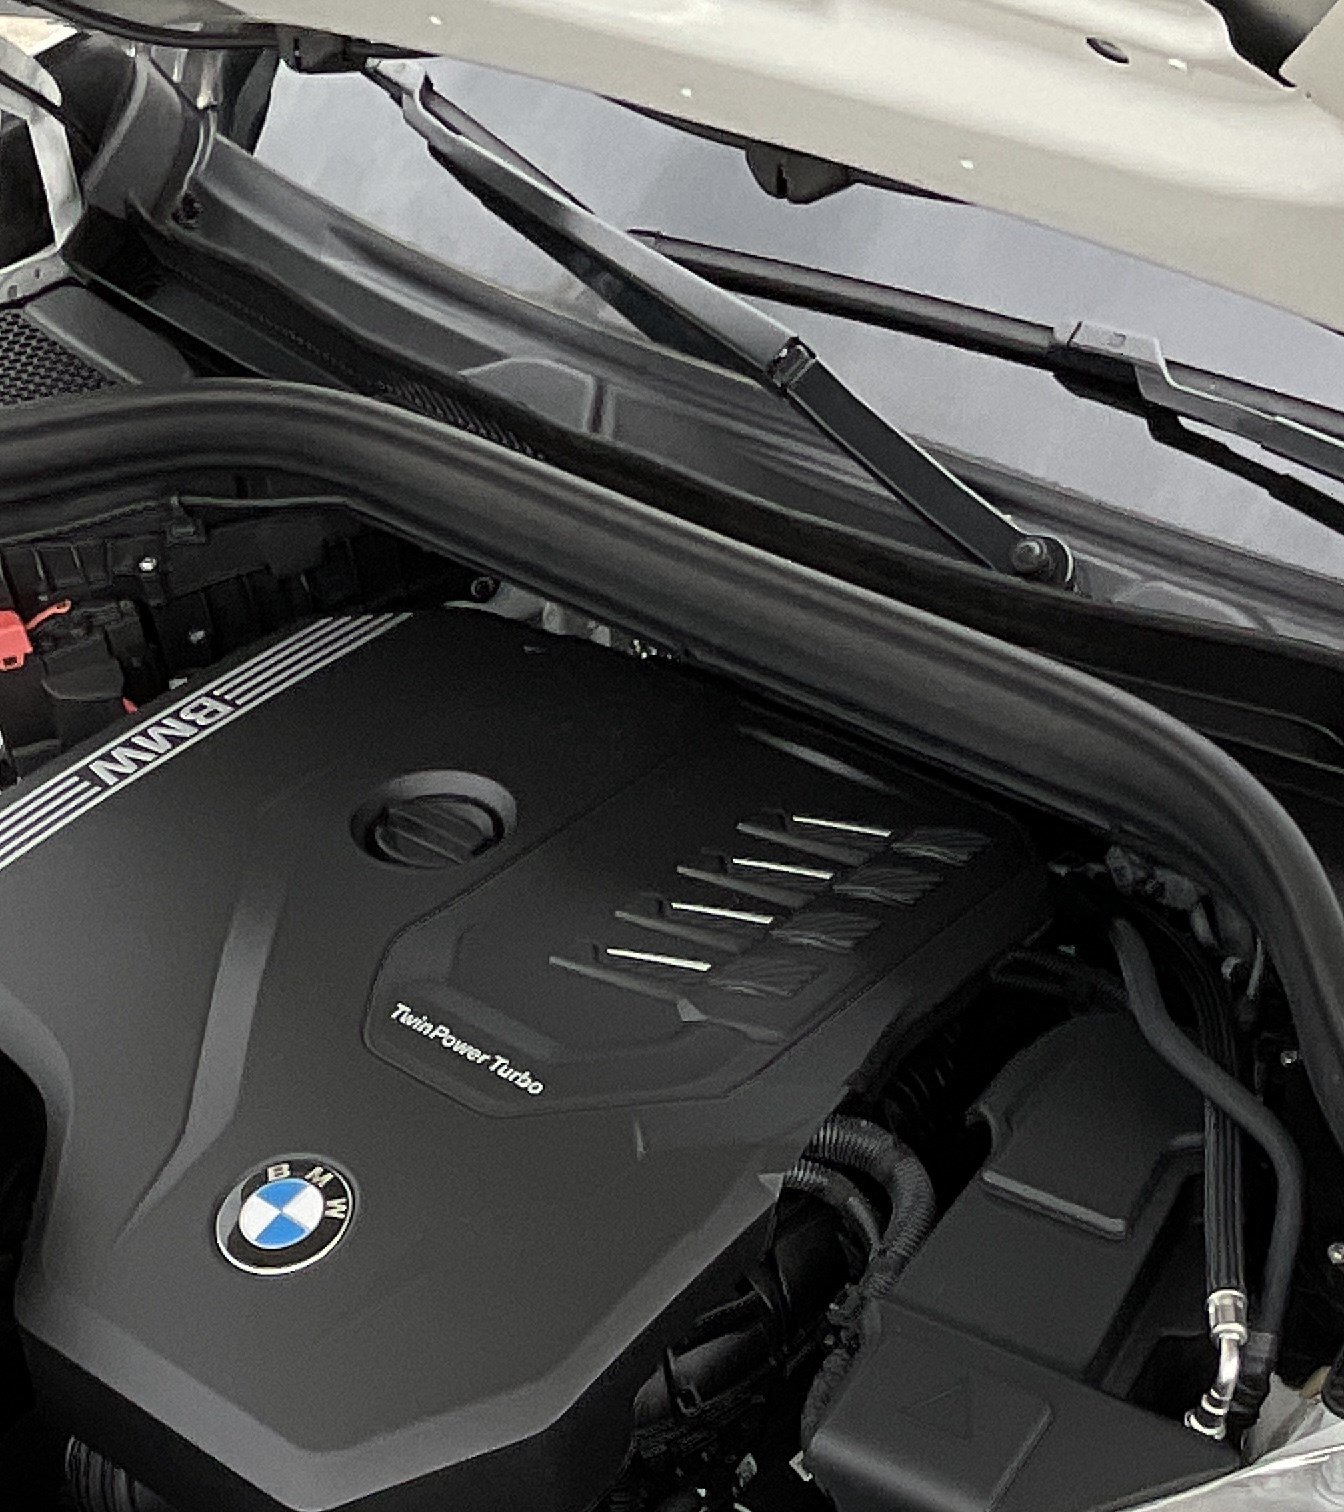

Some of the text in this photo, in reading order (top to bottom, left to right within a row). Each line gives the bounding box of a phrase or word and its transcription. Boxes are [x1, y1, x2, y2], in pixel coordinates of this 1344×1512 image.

[88, 696, 235, 786] BMW
[391, 1002, 544, 1096] TwinPower Turbo
[267, 1163, 348, 1220] BMW
